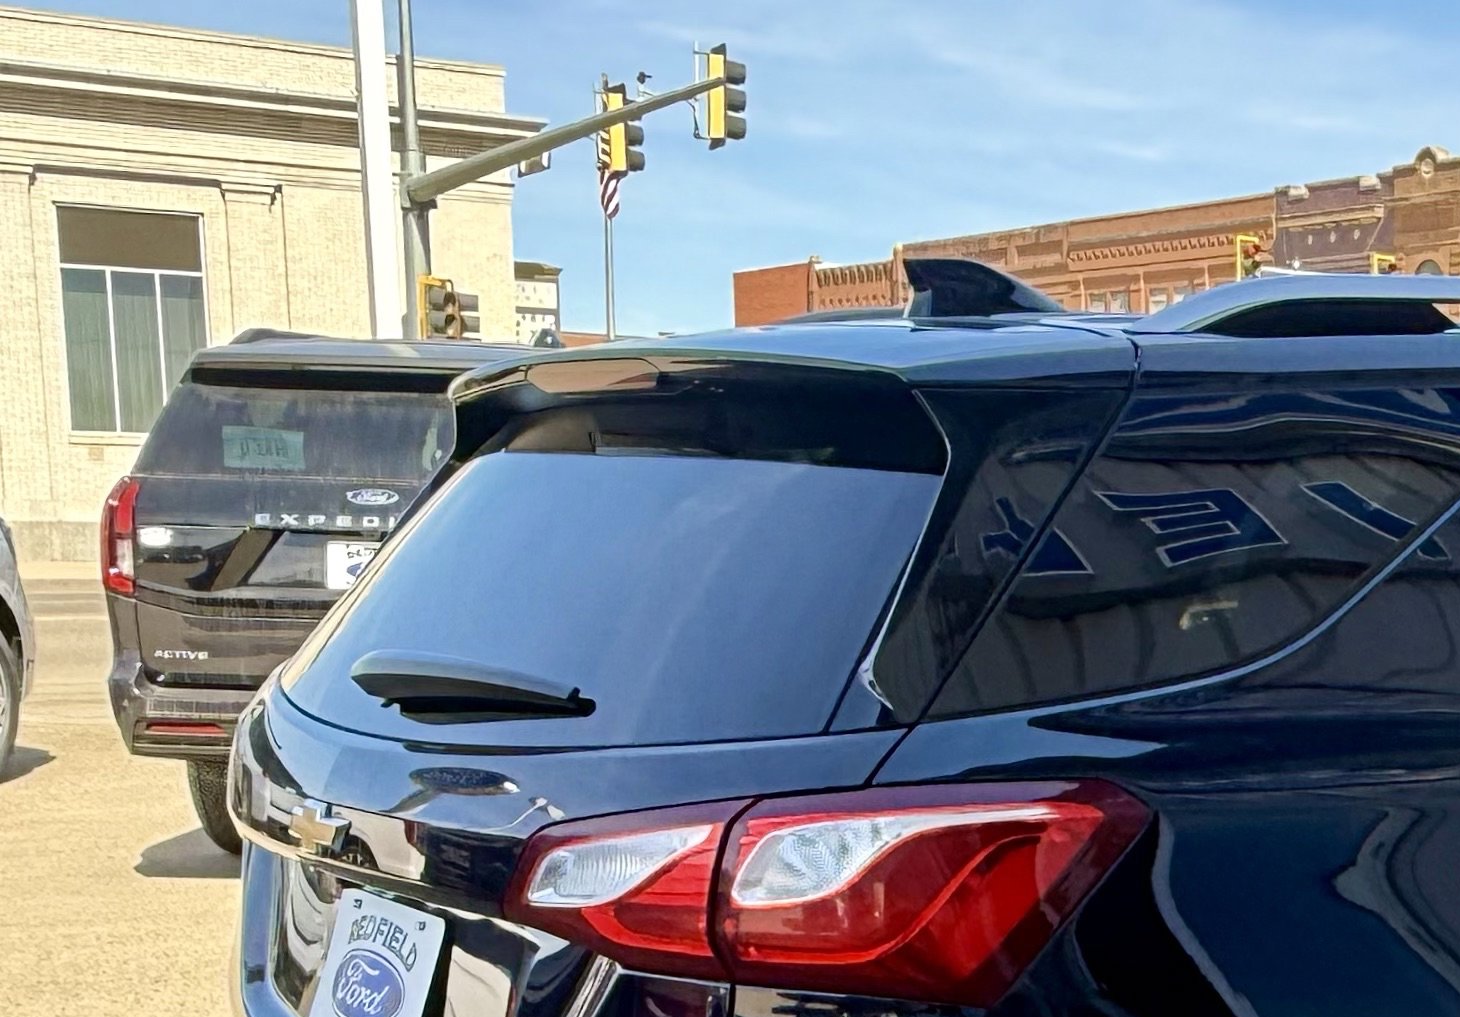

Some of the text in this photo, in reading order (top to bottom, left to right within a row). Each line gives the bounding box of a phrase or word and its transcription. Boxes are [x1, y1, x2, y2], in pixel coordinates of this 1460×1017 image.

[154, 649, 209, 660] ACTIVE
[348, 914, 417, 972] REDFIELD
[335, 957, 392, 1017] Ford
